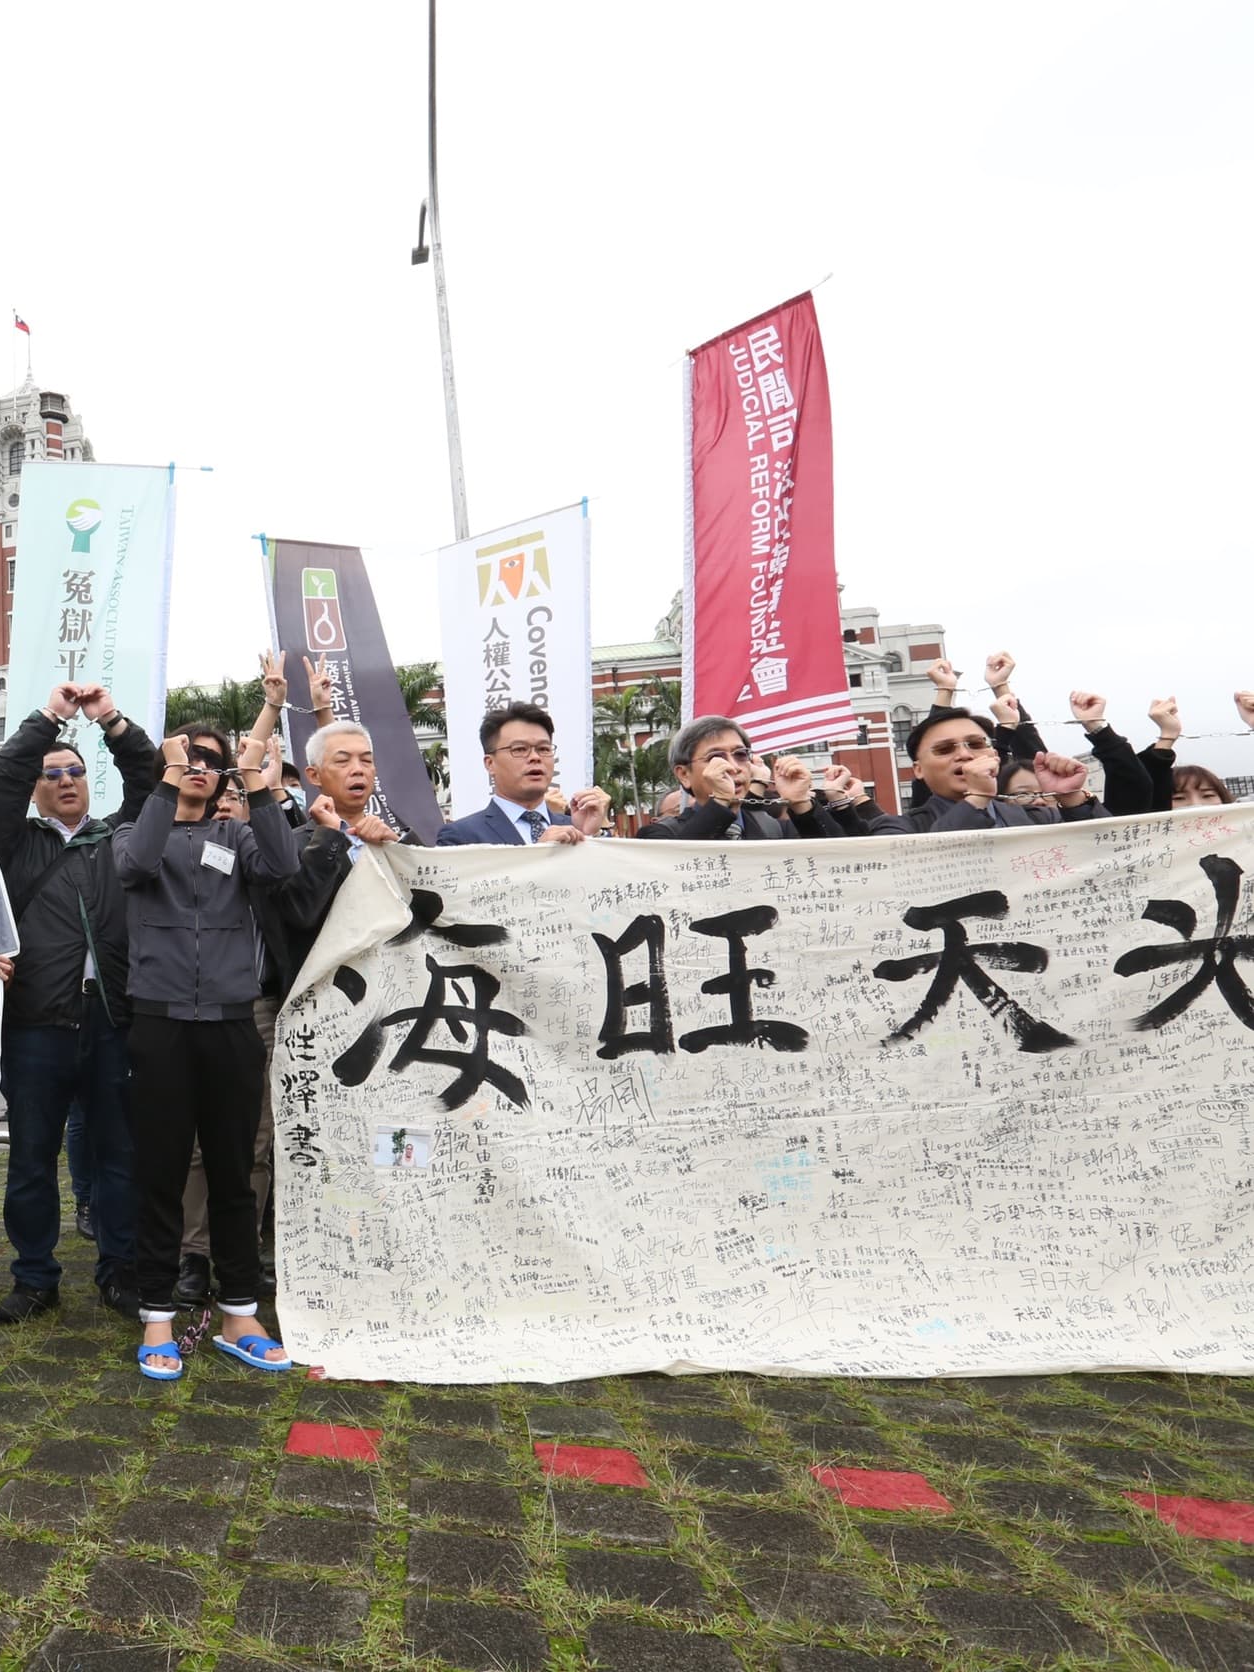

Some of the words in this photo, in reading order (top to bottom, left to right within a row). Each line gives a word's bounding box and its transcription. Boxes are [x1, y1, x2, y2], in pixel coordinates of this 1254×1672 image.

[728, 343, 766, 451] JUDICIAL
[749, 453, 771, 556] REFORM
[115, 504, 135, 566] TAIWAN
[100, 569, 124, 672] ASSOCIATION
[341, 660, 355, 697] Taiwan
[1149, 962, 1194, 992] 人生百味
[431, 1159, 470, 1178] Mido
[1018, 1267, 1101, 1294] 早日天光
